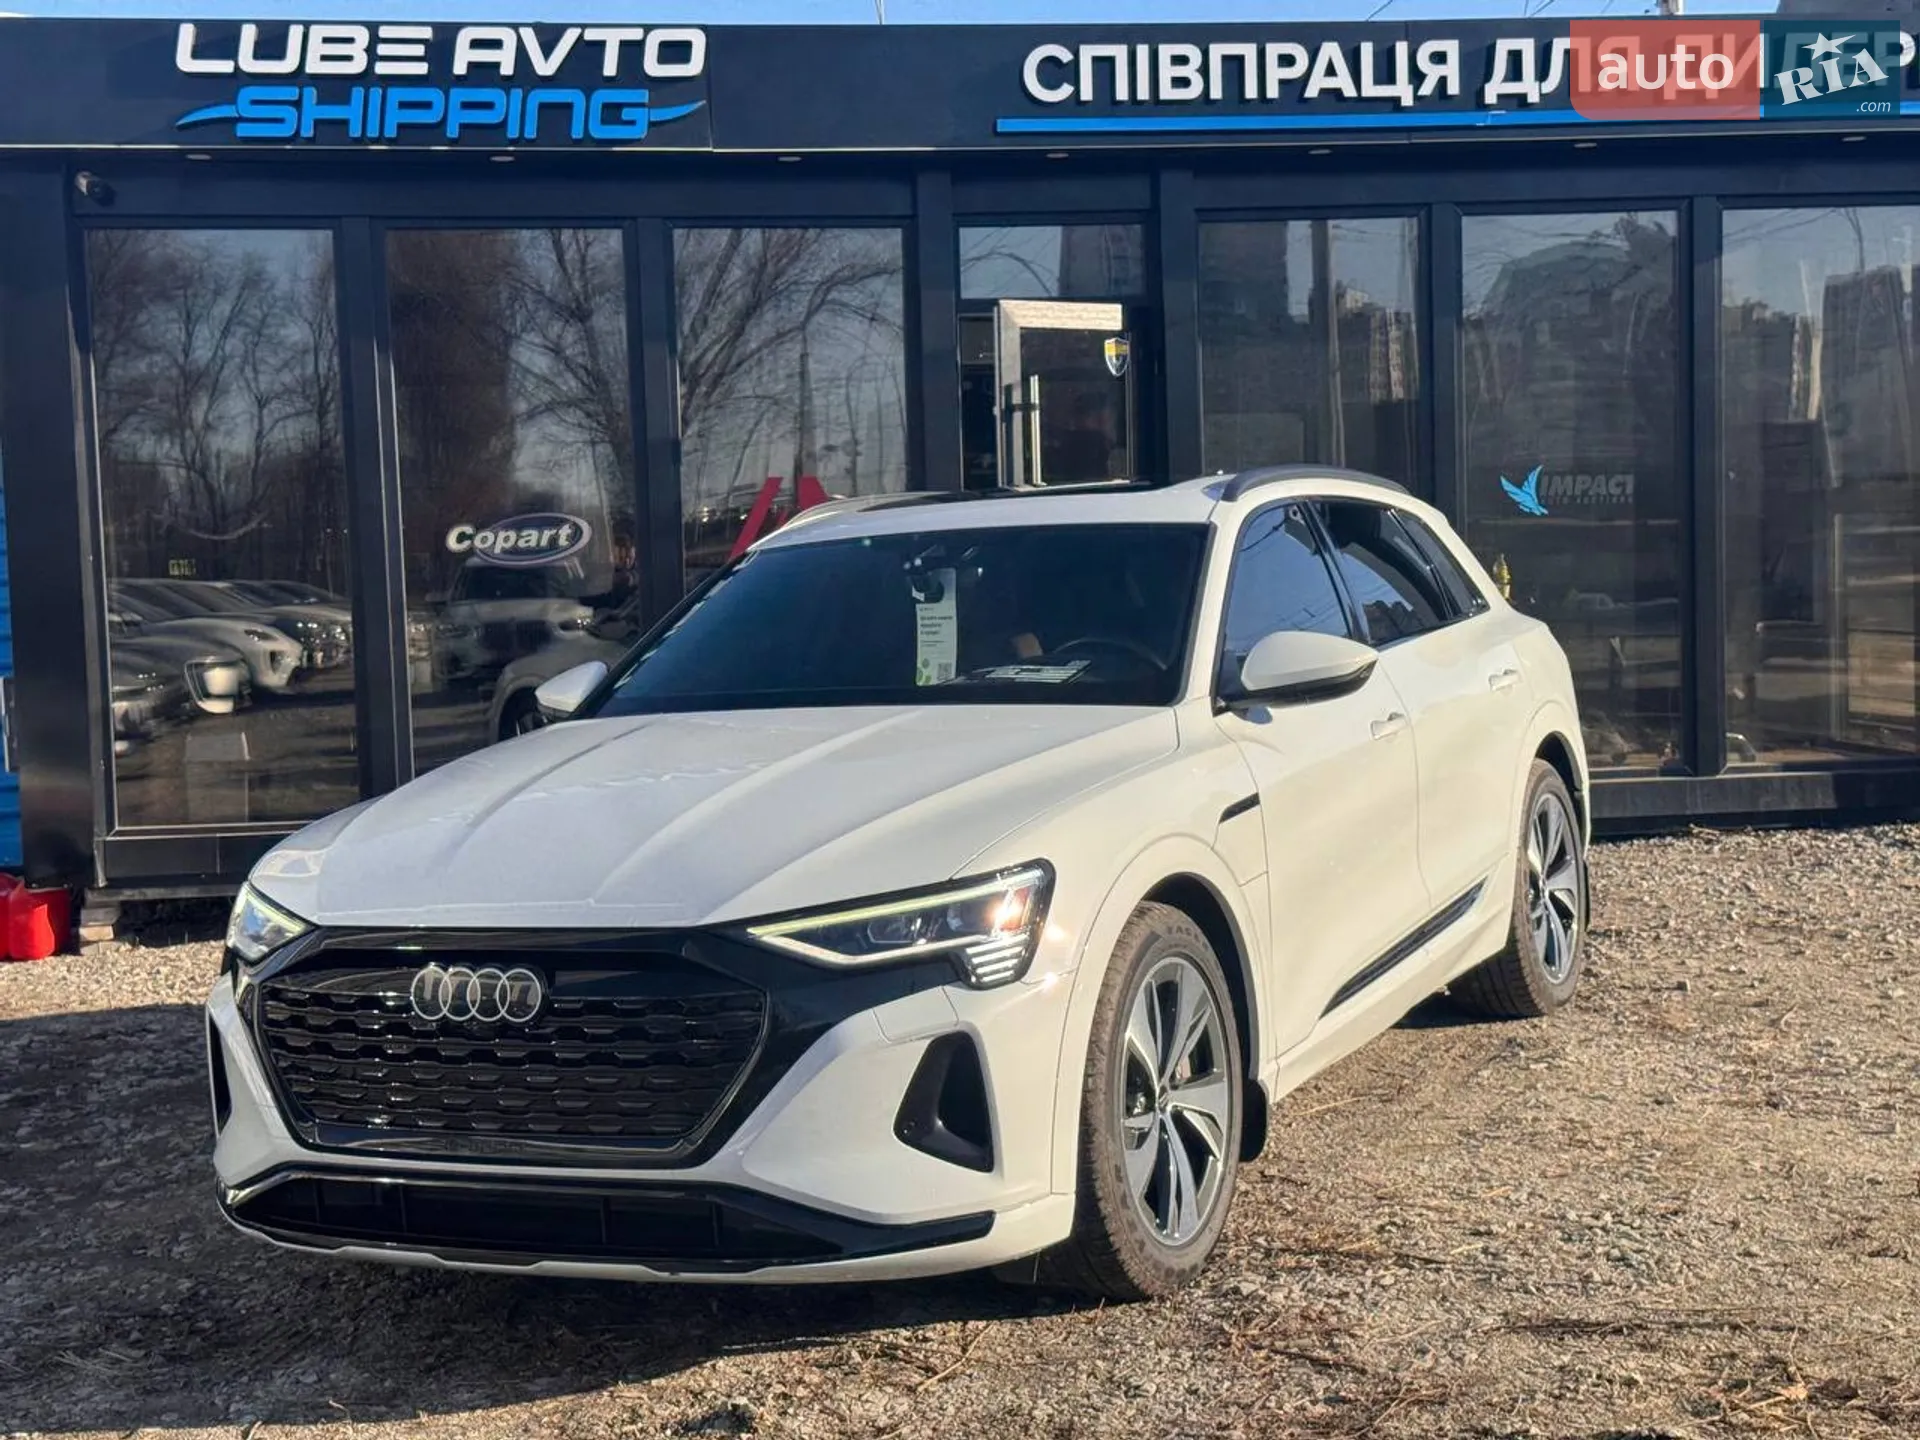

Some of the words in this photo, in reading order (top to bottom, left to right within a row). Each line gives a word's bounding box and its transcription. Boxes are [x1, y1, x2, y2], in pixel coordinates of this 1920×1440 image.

[176, 23, 433, 75] LUBE
[453, 27, 706, 77] AVTO
[1023, 39, 1460, 106] СПІВПРАЦЯ
[1484, 35, 1640, 104] ДЛЯ
[235, 85, 649, 139] SHIPPING
[1540, 473, 1635, 498] IMPACT
[445, 522, 573, 555] Copart
